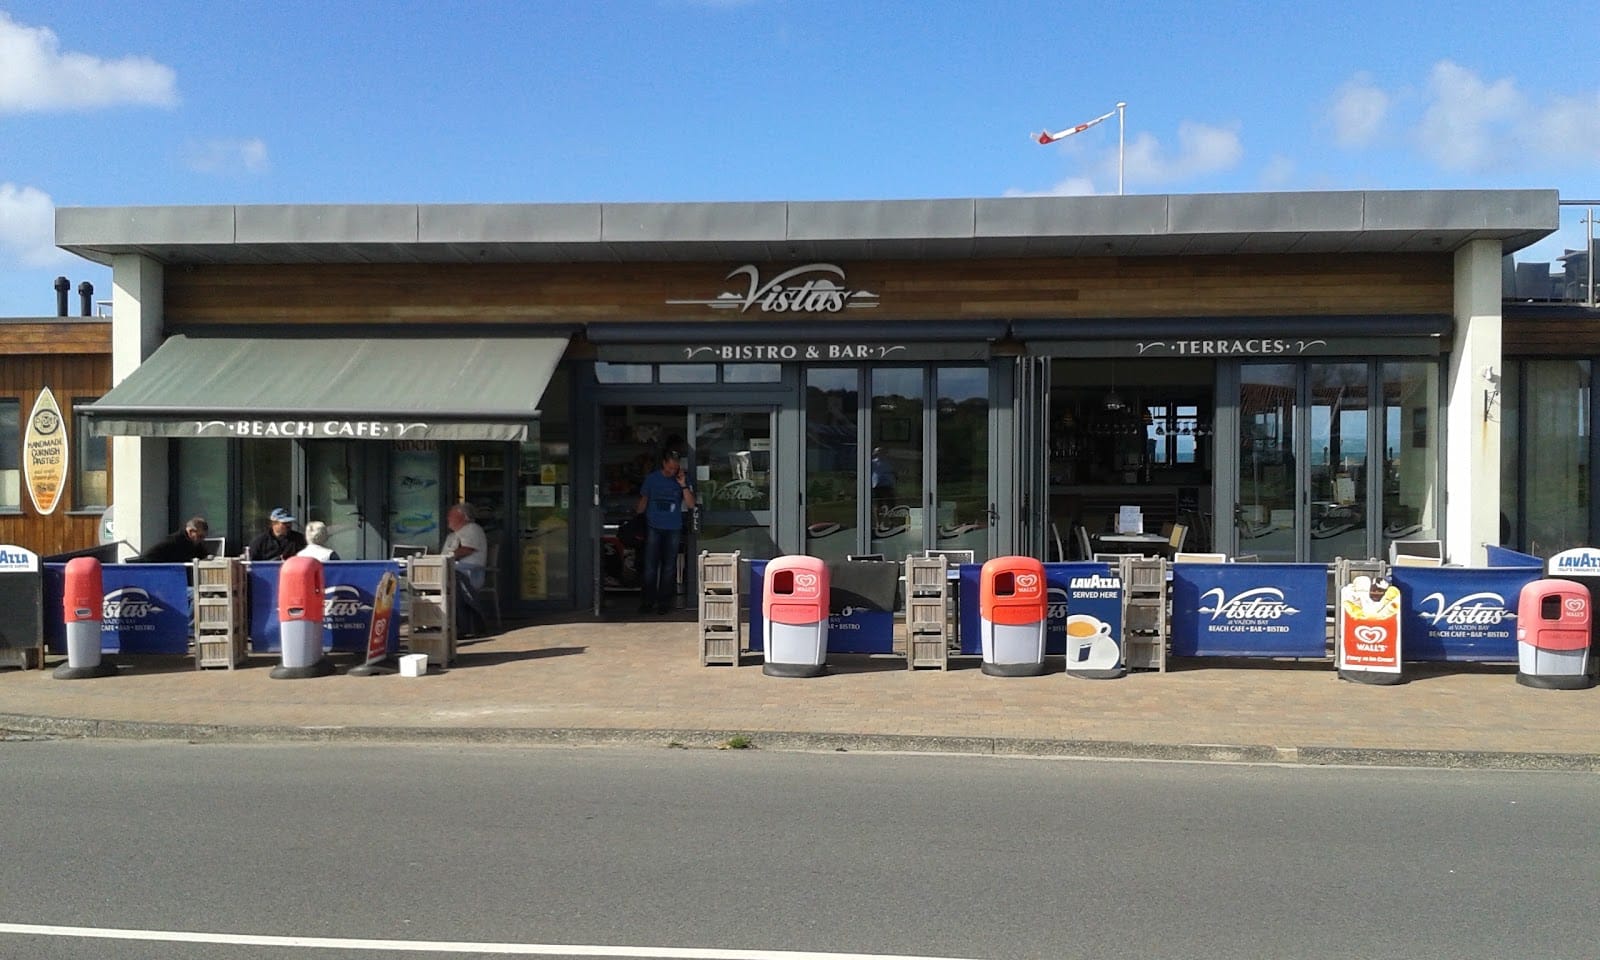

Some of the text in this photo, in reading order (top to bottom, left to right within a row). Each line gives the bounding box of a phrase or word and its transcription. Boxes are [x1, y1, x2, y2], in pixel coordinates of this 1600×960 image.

[725, 263, 852, 313] Vistas
[722, 345, 869, 359] BISTRO & BAR
[1177, 340, 1284, 354] TERRACES
[236, 421, 382, 437] BEACH CAFE
[28, 439, 62, 448] HANDMADE
[32, 448, 60, 457] CORNISH
[33, 457, 60, 465] PASTIES
[0, 550, 29, 563] AZZA
[1070, 575, 1121, 589] LAVAZZA
[1073, 591, 1099, 599] SERVED
[1200, 587, 1288, 620] Vistas
[1420, 592, 1508, 625] Vistas
[1208, 625, 1229, 633] BEACH
[1230, 625, 1245, 633] CAFE
[1356, 643, 1388, 653] WALL'S
